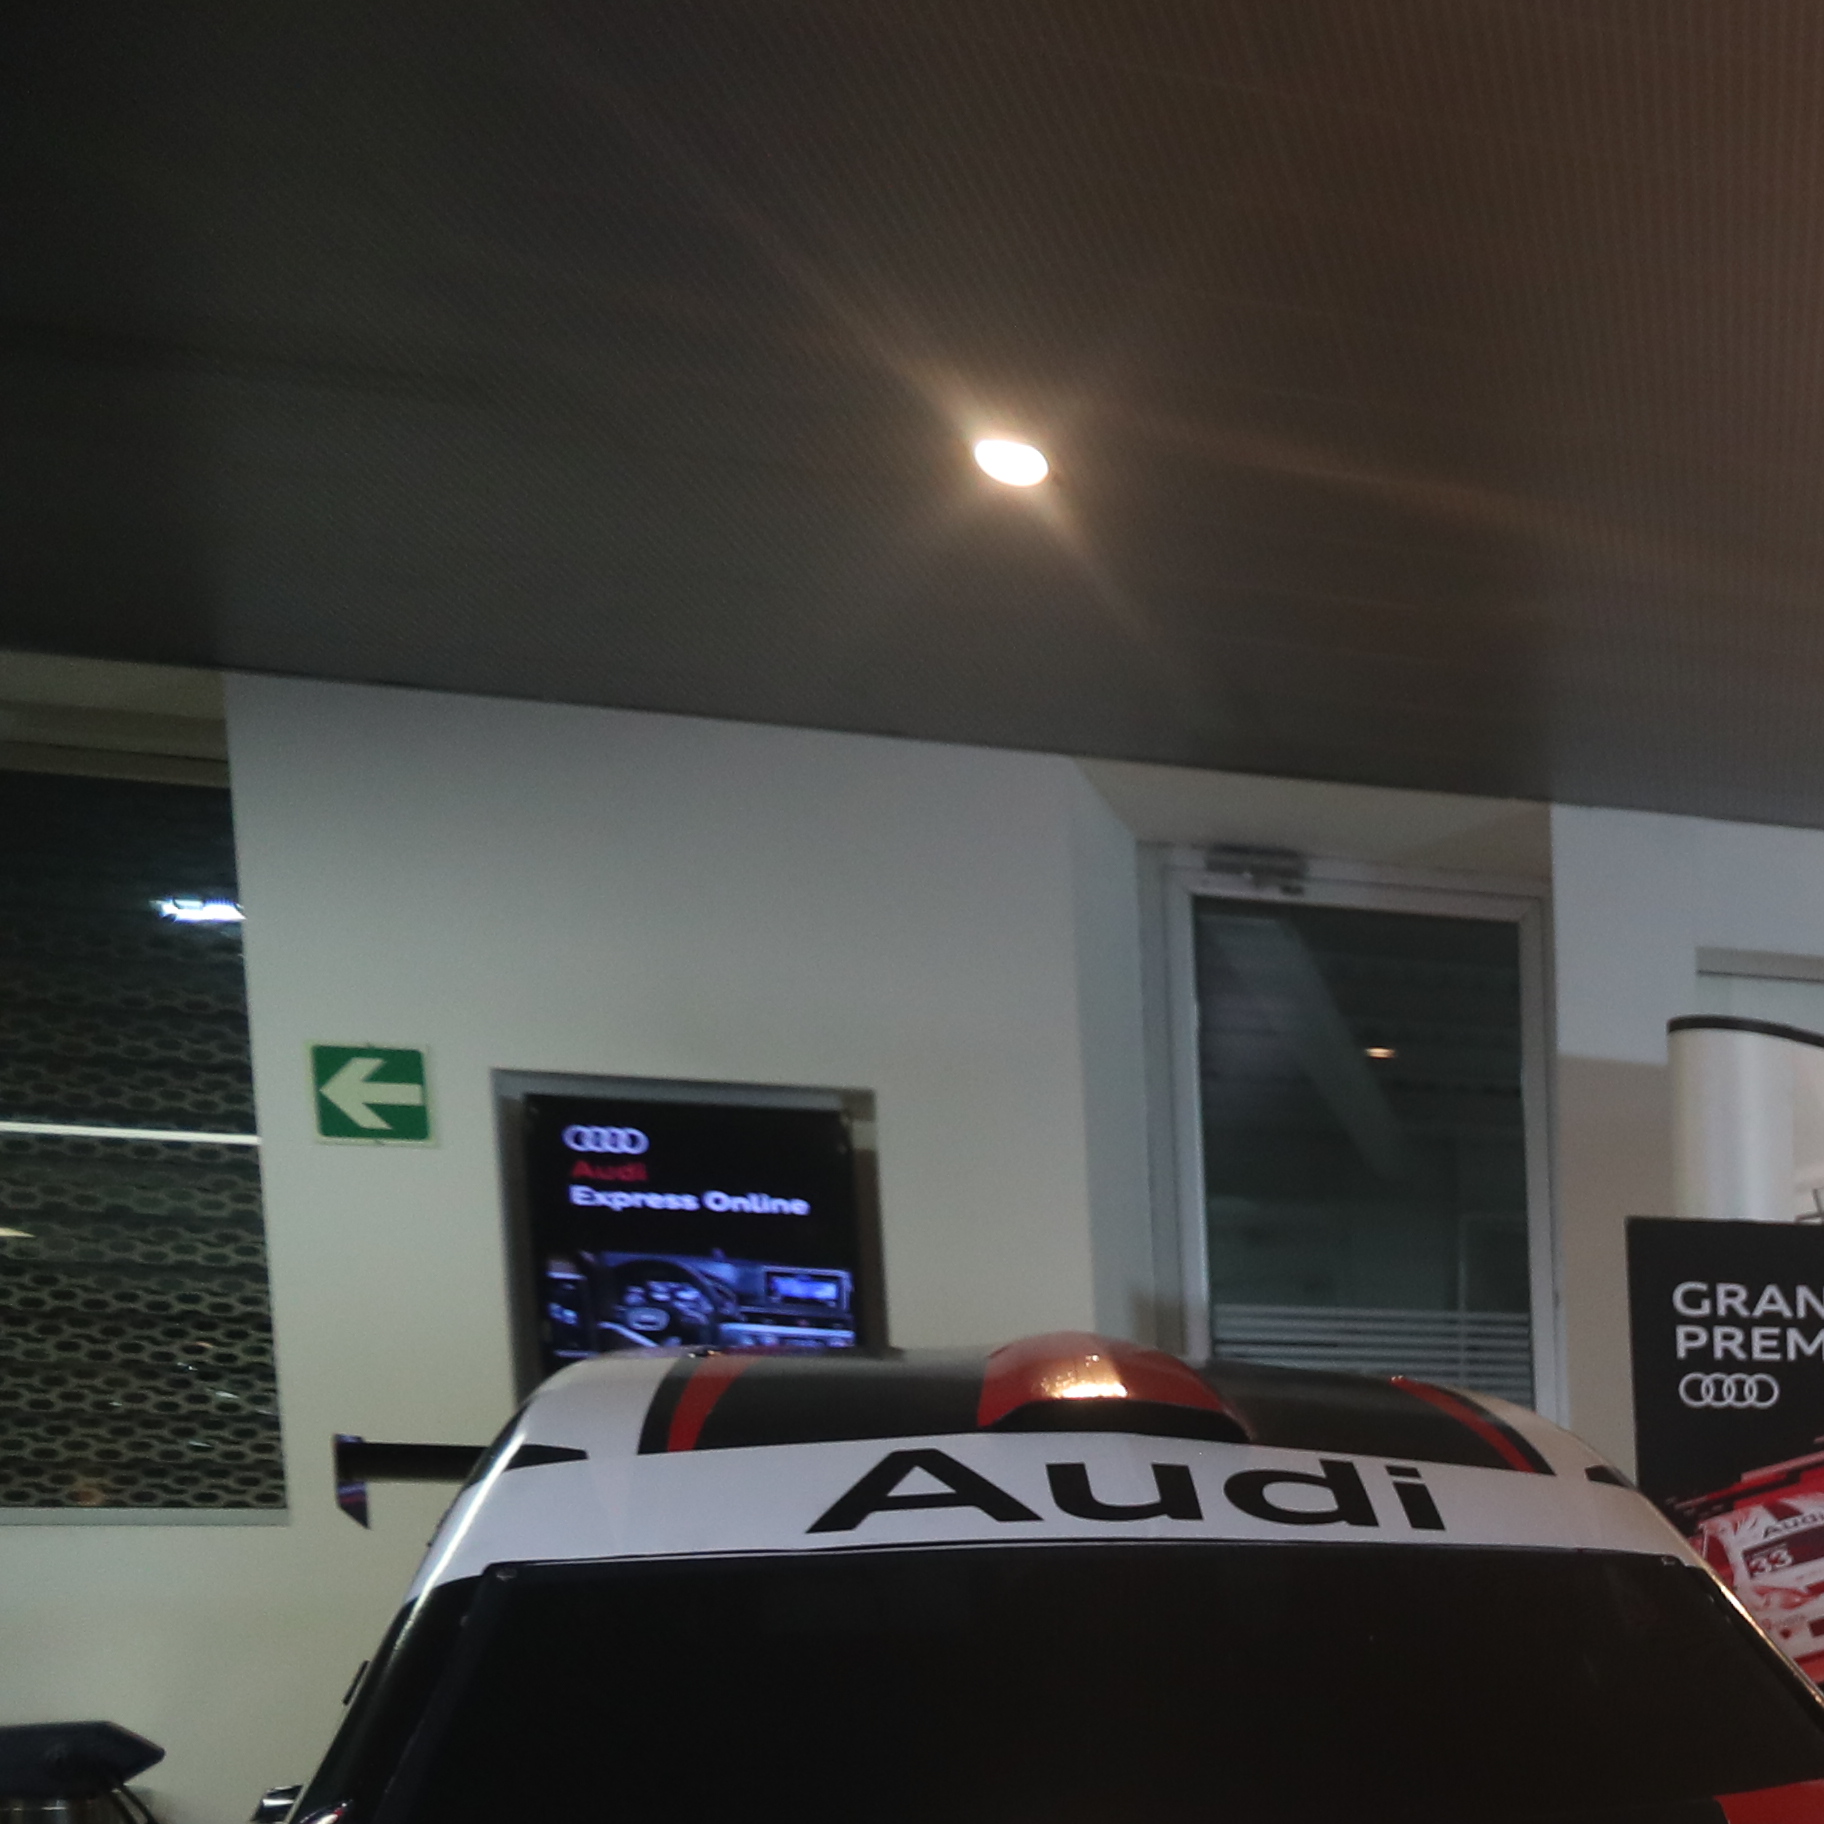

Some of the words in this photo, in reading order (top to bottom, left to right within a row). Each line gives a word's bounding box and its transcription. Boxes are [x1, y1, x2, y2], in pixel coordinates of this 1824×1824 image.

[571, 1160, 648, 1181] Audi
[569, 1185, 700, 1211] Express
[702, 1190, 811, 1215] Online
[806, 1448, 1446, 1534] Audi
